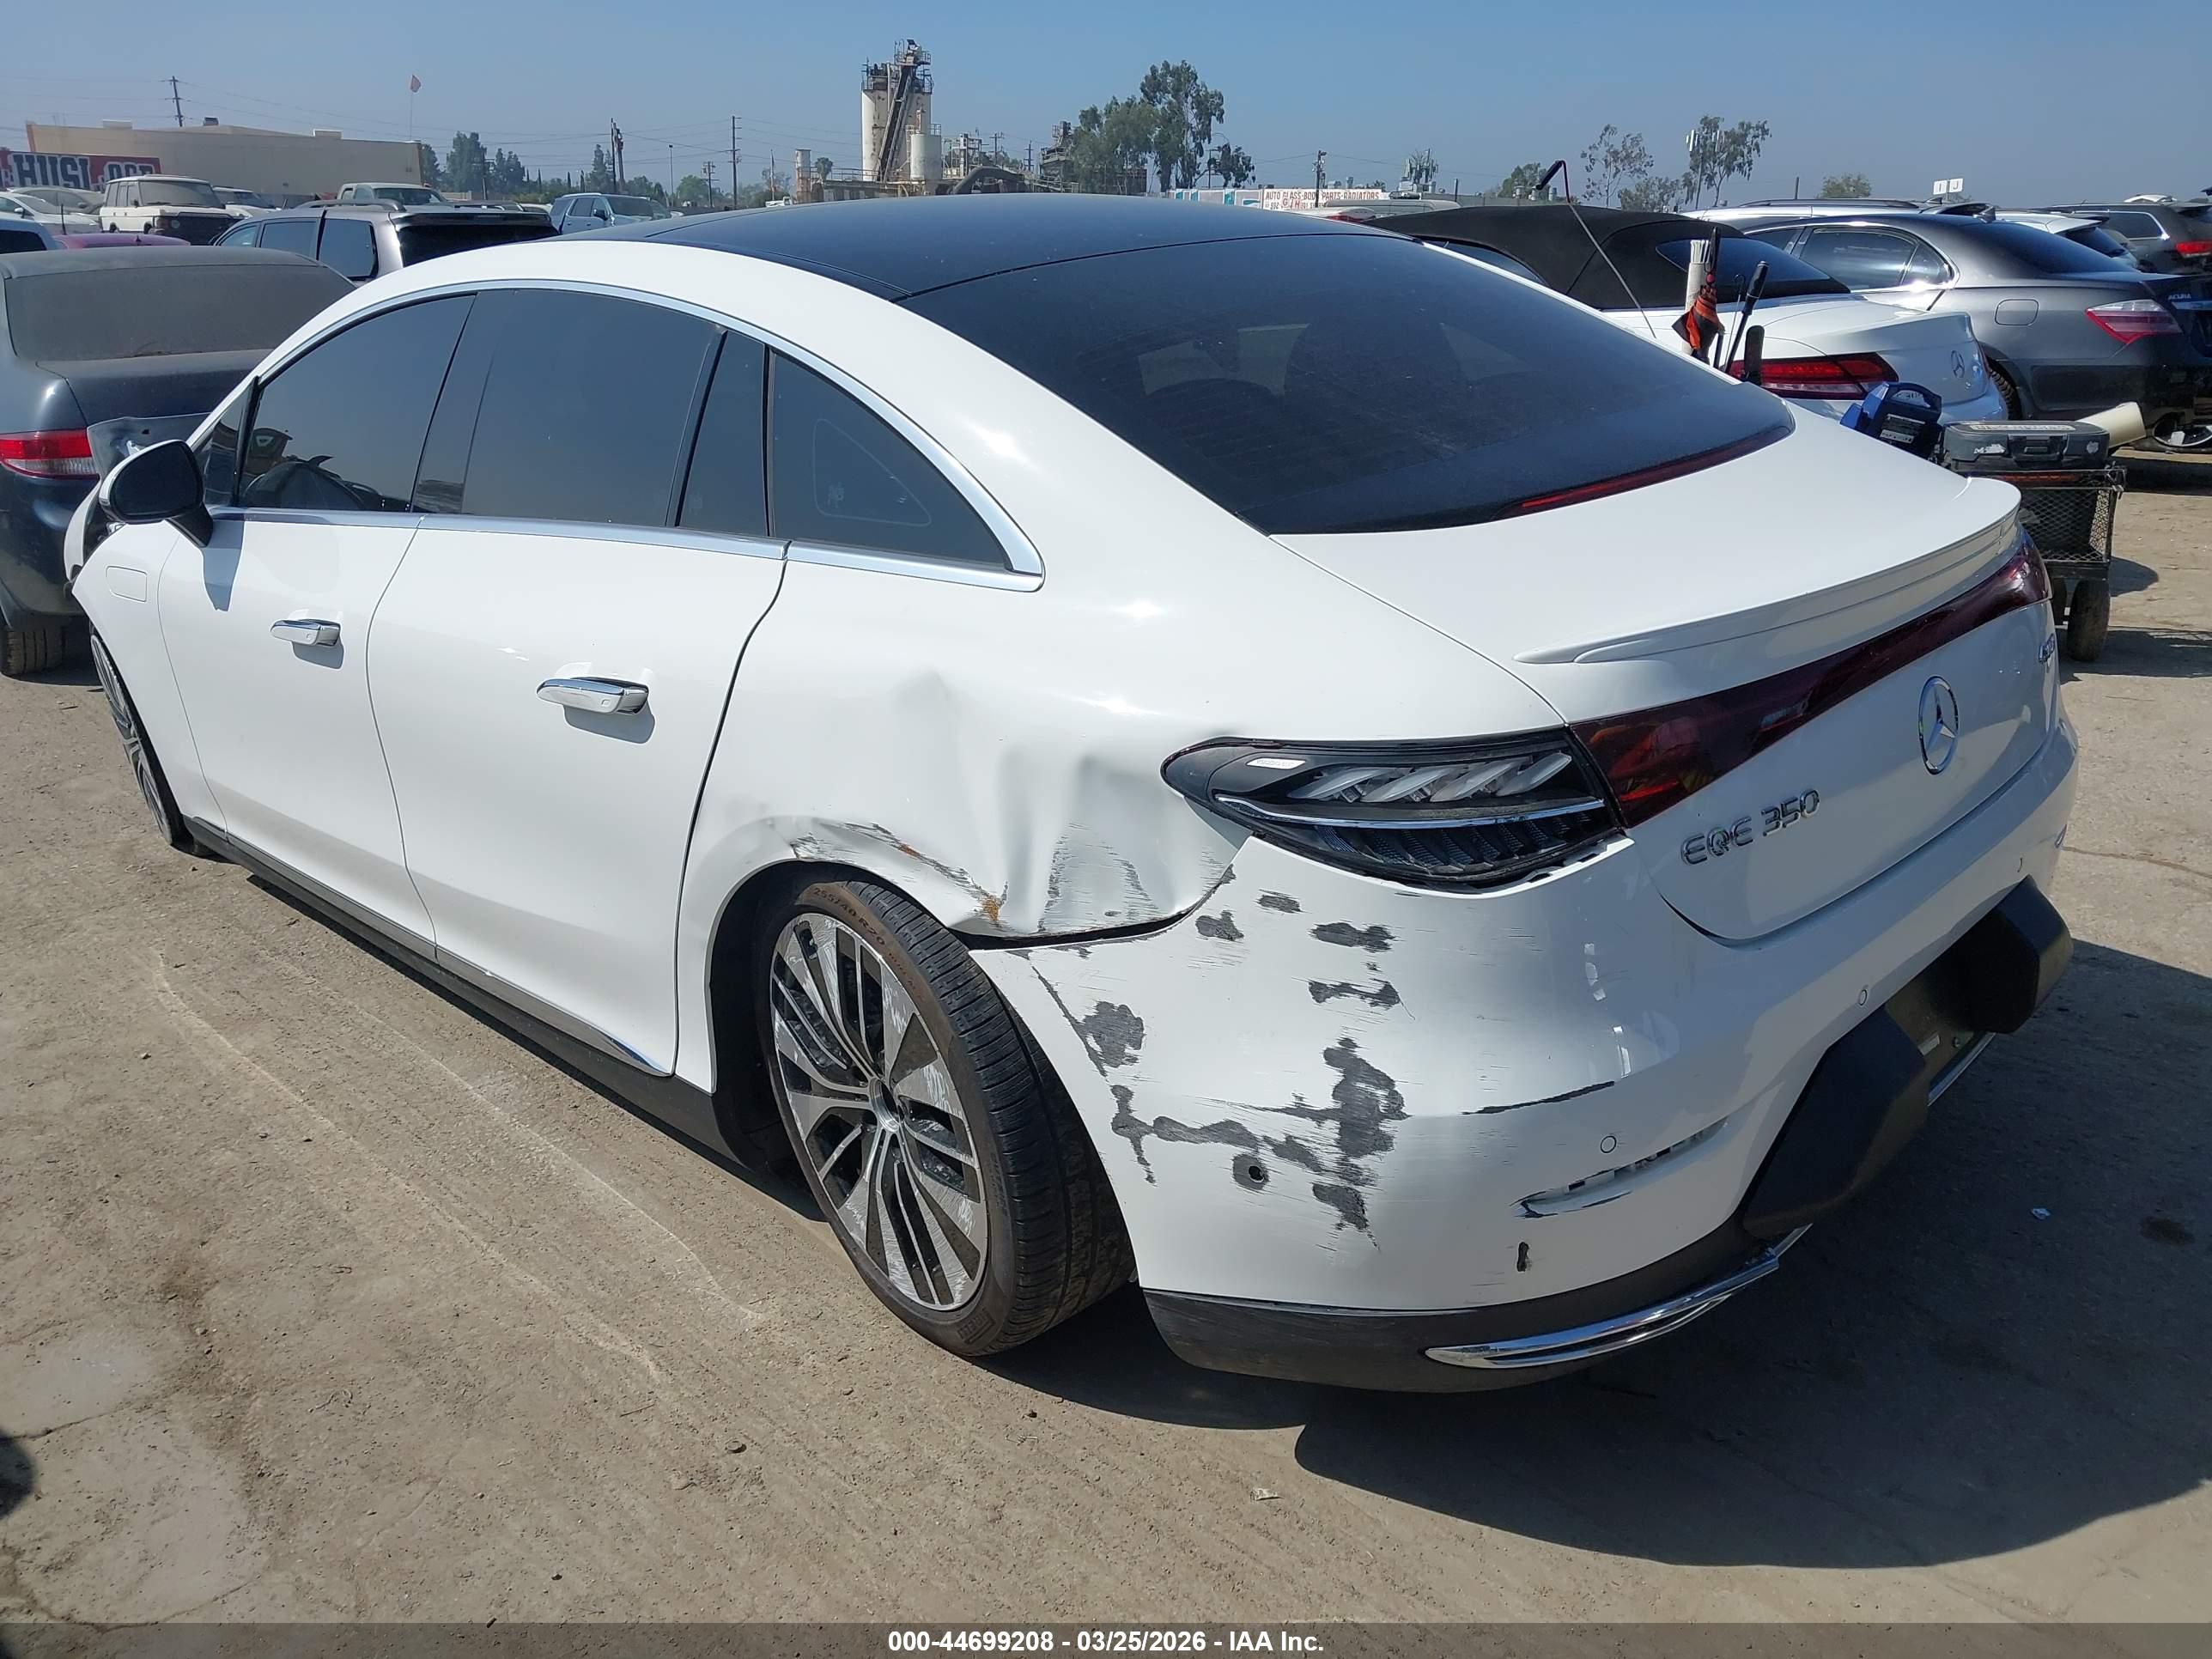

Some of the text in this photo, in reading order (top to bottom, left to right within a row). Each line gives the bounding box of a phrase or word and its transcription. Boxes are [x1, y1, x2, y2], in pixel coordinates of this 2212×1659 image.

[1952, 181, 1959, 191] J
[1266, 191, 1280, 200] AUTO
[1680, 788, 1820, 866] EQE 350
